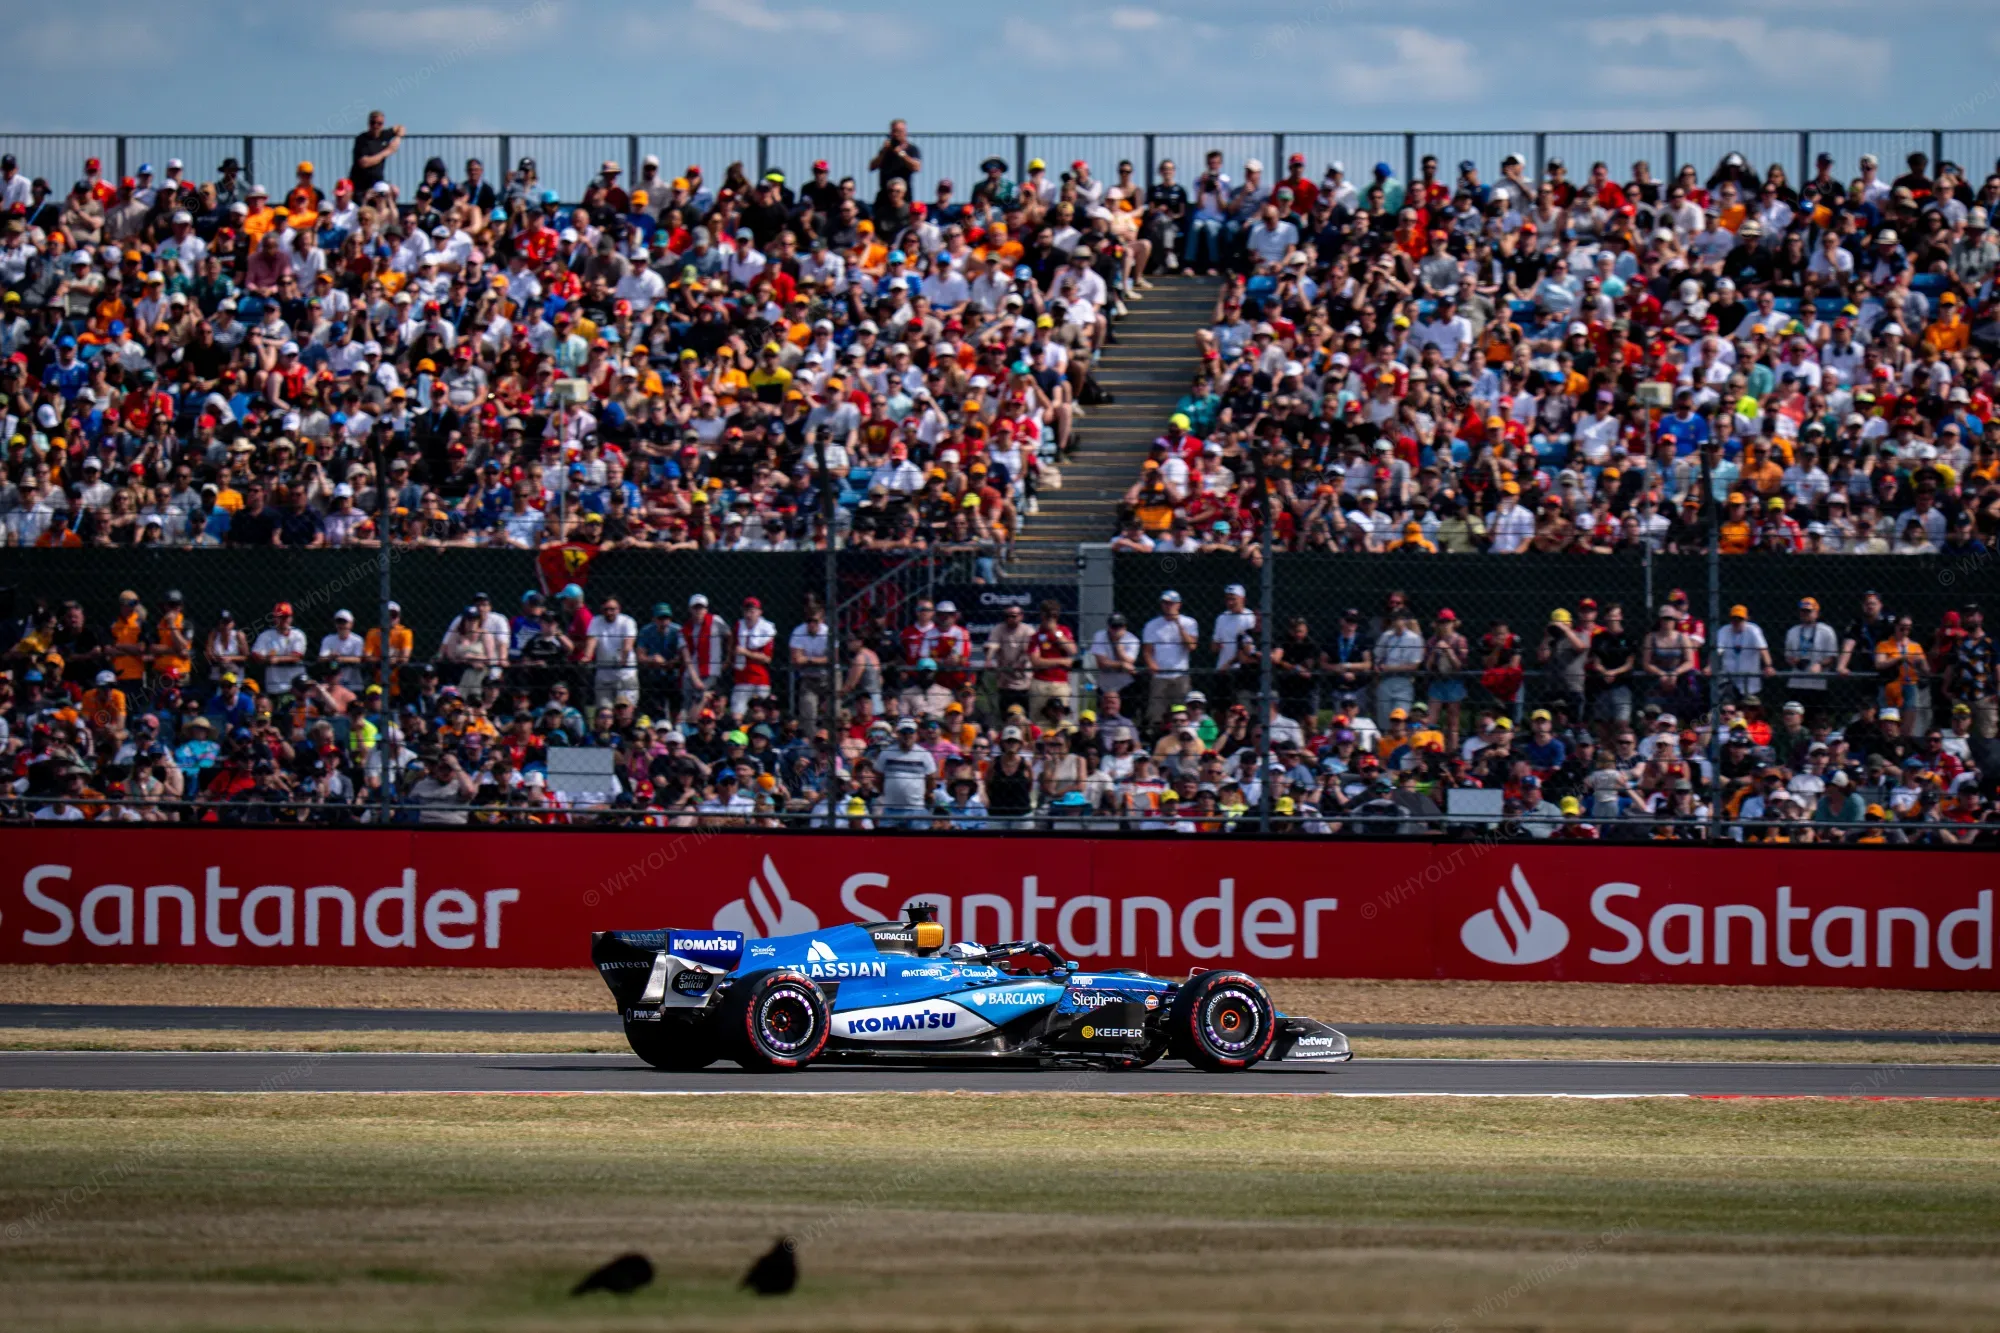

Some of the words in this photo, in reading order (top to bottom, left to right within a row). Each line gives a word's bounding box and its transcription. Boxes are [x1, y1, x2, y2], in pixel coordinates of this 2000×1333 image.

[23, 865, 519, 950] Santander
[874, 932, 913, 941] DURACELL
[674, 937, 737, 951] KOMATSU
[600, 960, 649, 971] nuveen
[777, 961, 886, 978] TLASSIAN
[962, 966, 998, 978] Claude
[1218, 975, 1257, 989] ZERO
[988, 993, 1045, 1005] BARCLAYS
[848, 1009, 956, 1034] KOMATSU
[1095, 1028, 1142, 1037] KEEPER
[1298, 1036, 1333, 1047] betway
